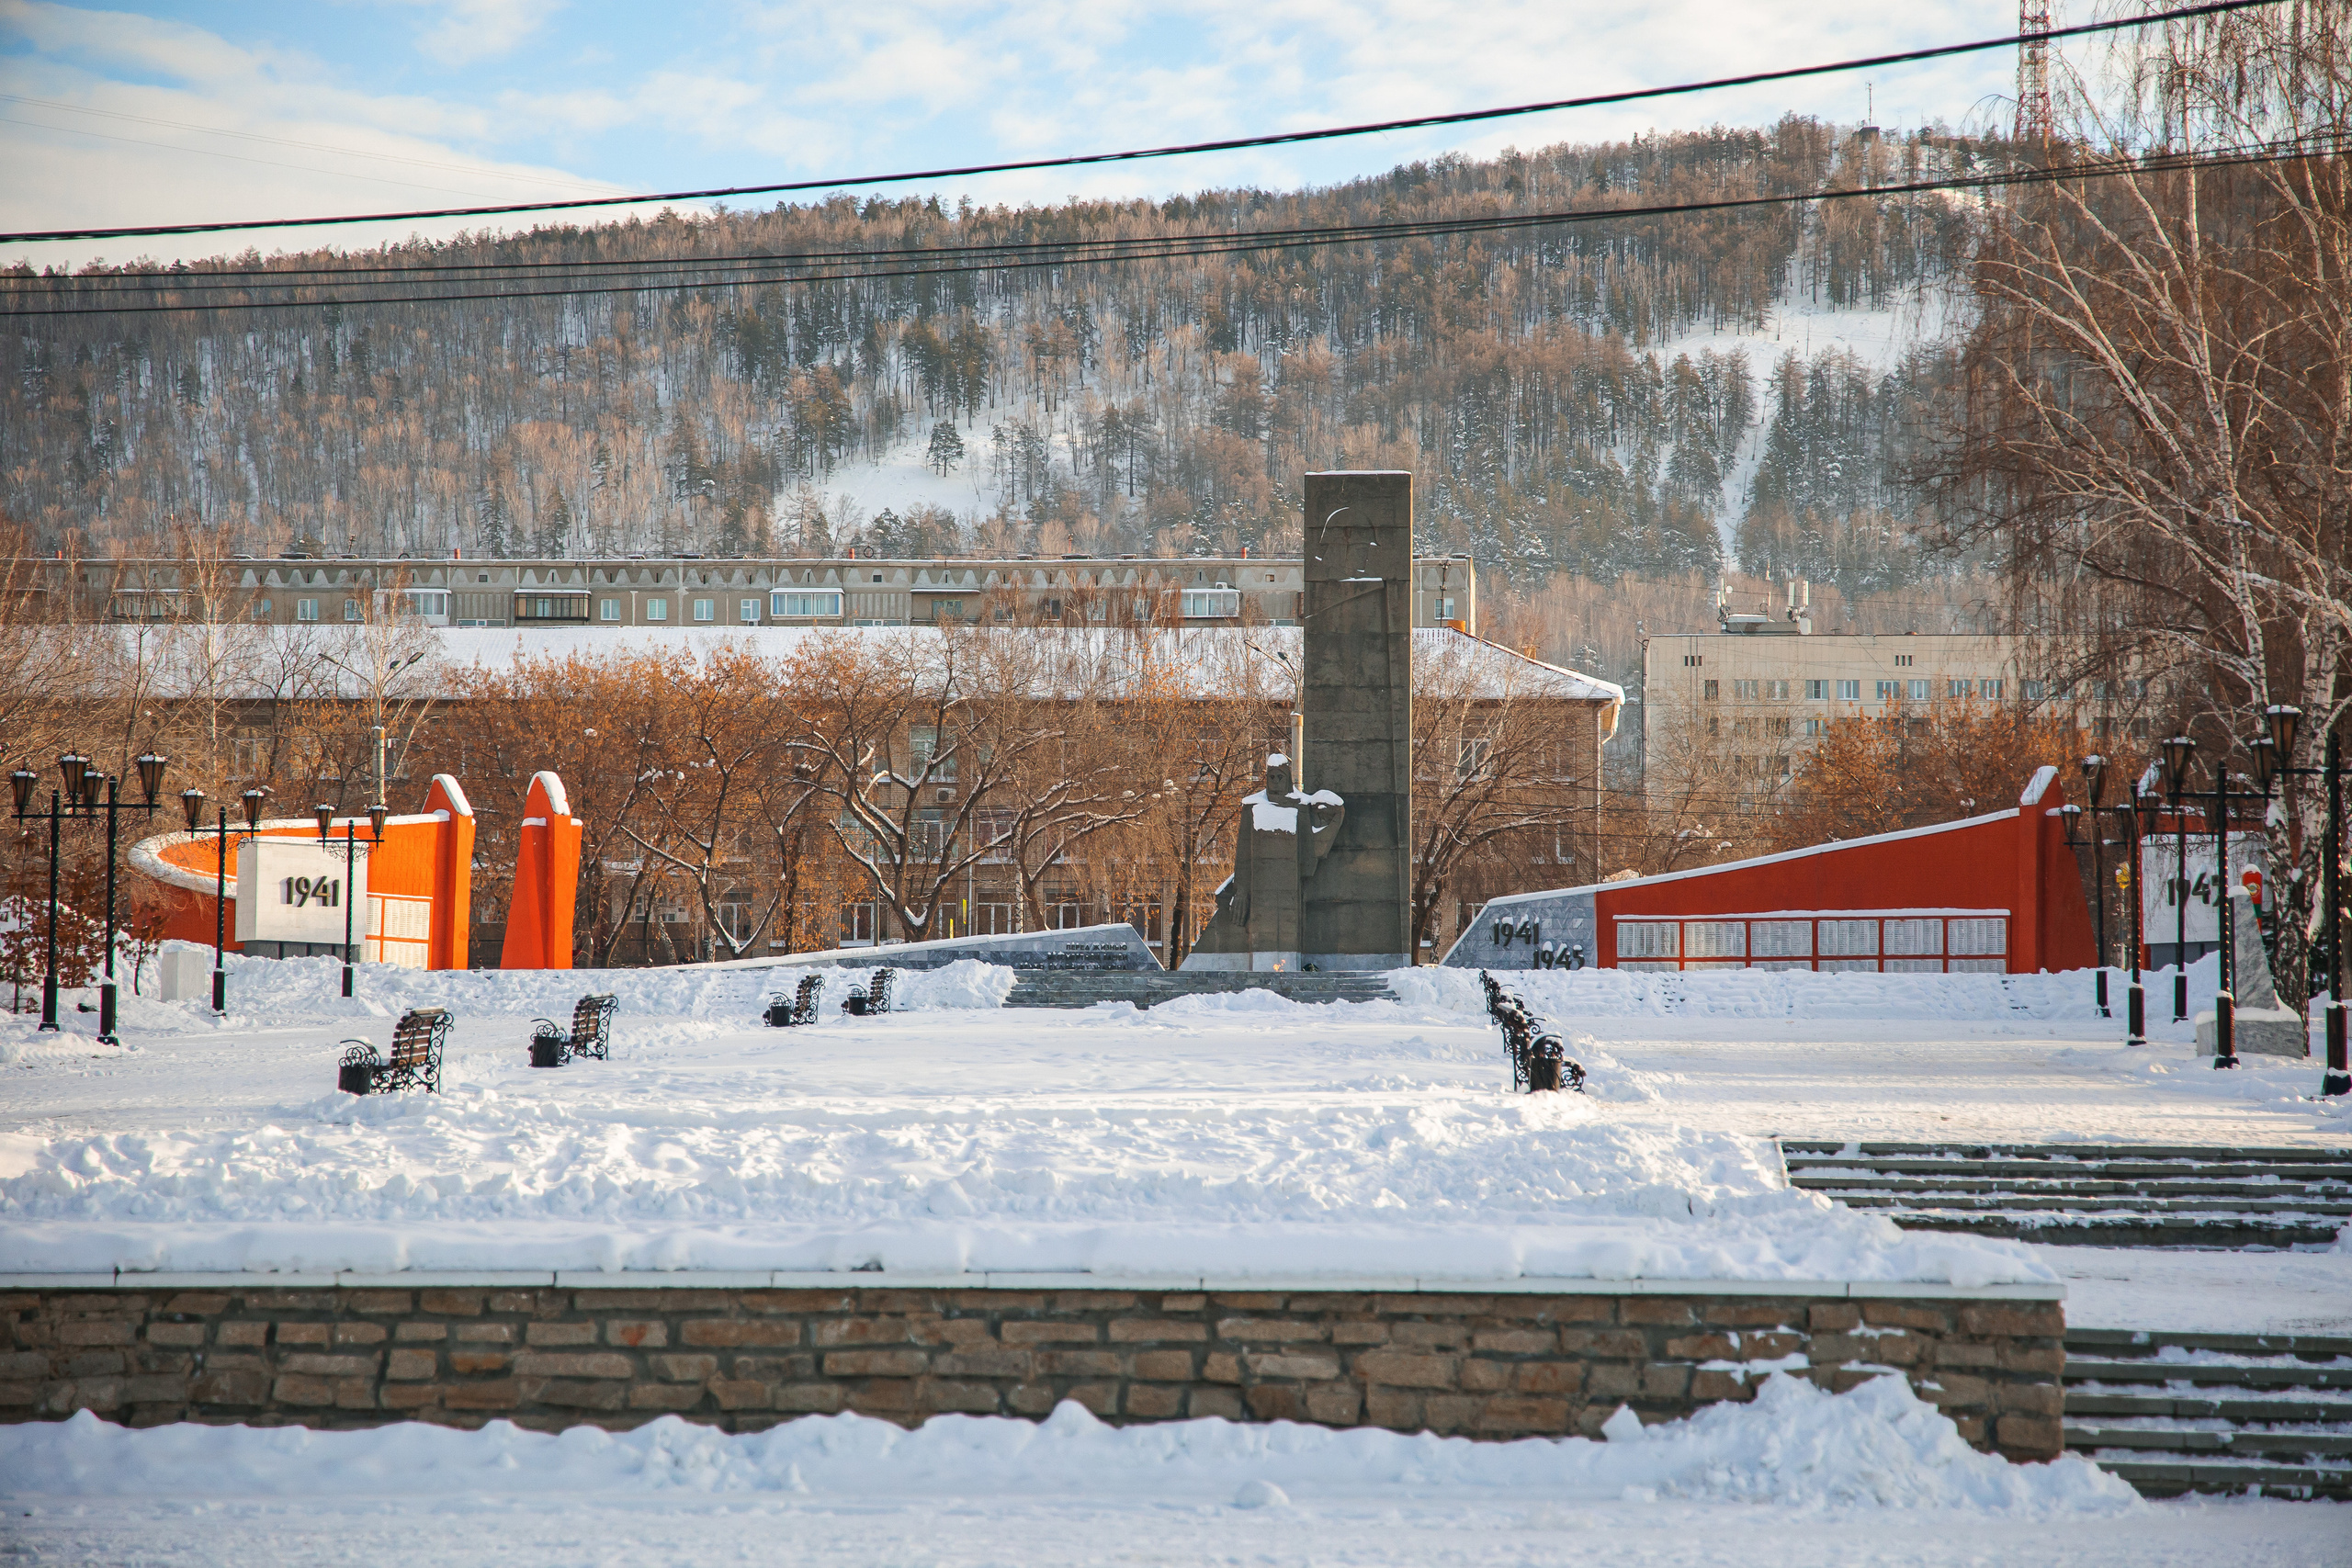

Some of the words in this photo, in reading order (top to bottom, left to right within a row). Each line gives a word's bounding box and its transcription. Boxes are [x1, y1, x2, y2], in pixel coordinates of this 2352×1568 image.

[285, 875, 340, 908] 1941
[1493, 919, 1541, 946] 1941
[1532, 945, 1586, 970] 1945
